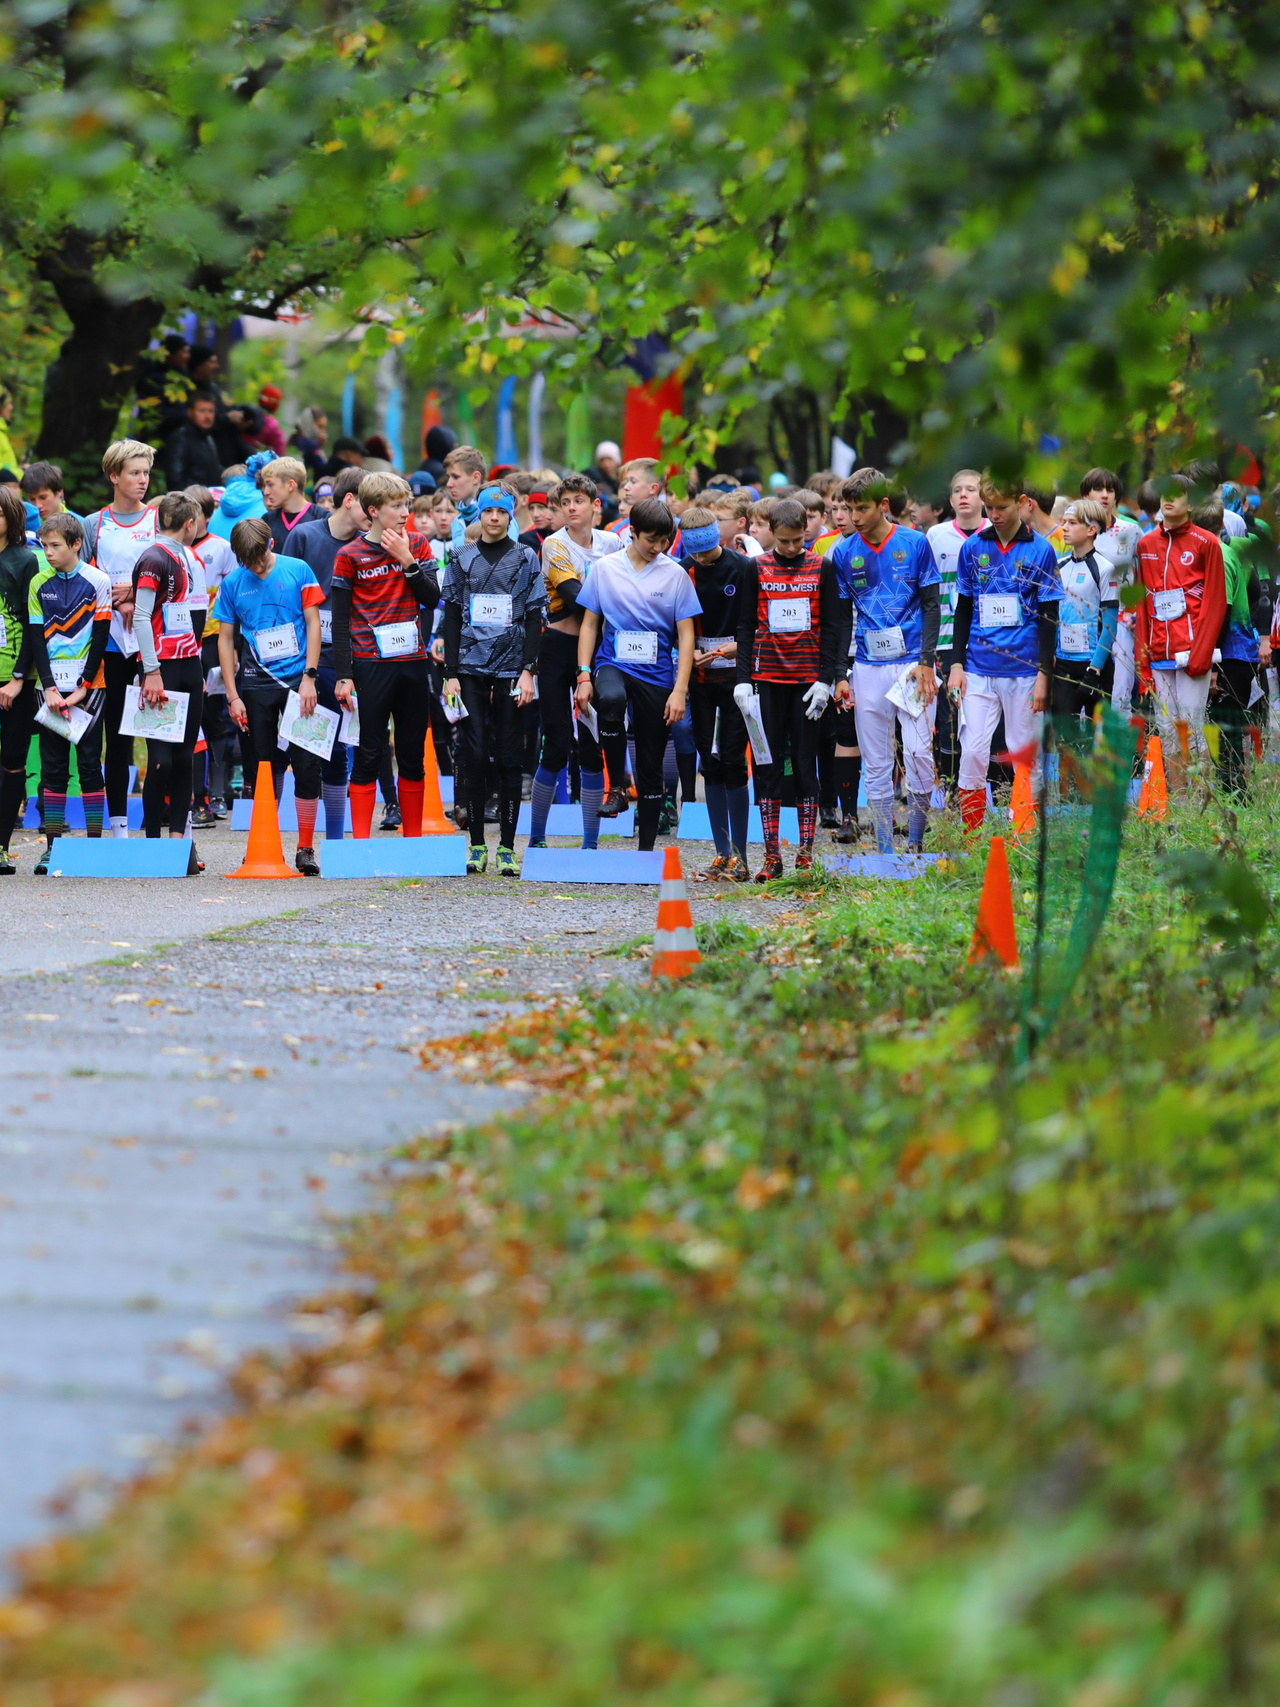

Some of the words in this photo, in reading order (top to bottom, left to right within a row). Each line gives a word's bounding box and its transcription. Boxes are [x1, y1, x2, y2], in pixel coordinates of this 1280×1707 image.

[357, 564, 389, 580] NORD
[761, 582, 787, 593] NORD
[790, 582, 819, 592] WEST
[482, 606, 497, 615] 207
[782, 609, 797, 617] 203
[992, 606, 1006, 615] 201
[268, 639, 283, 650] 209
[391, 636, 405, 645] 208
[876, 640, 891, 649] 202
[627, 643, 643, 651] 205
[54, 672, 69, 681] 213
[762, 815, 770, 841] NORD
